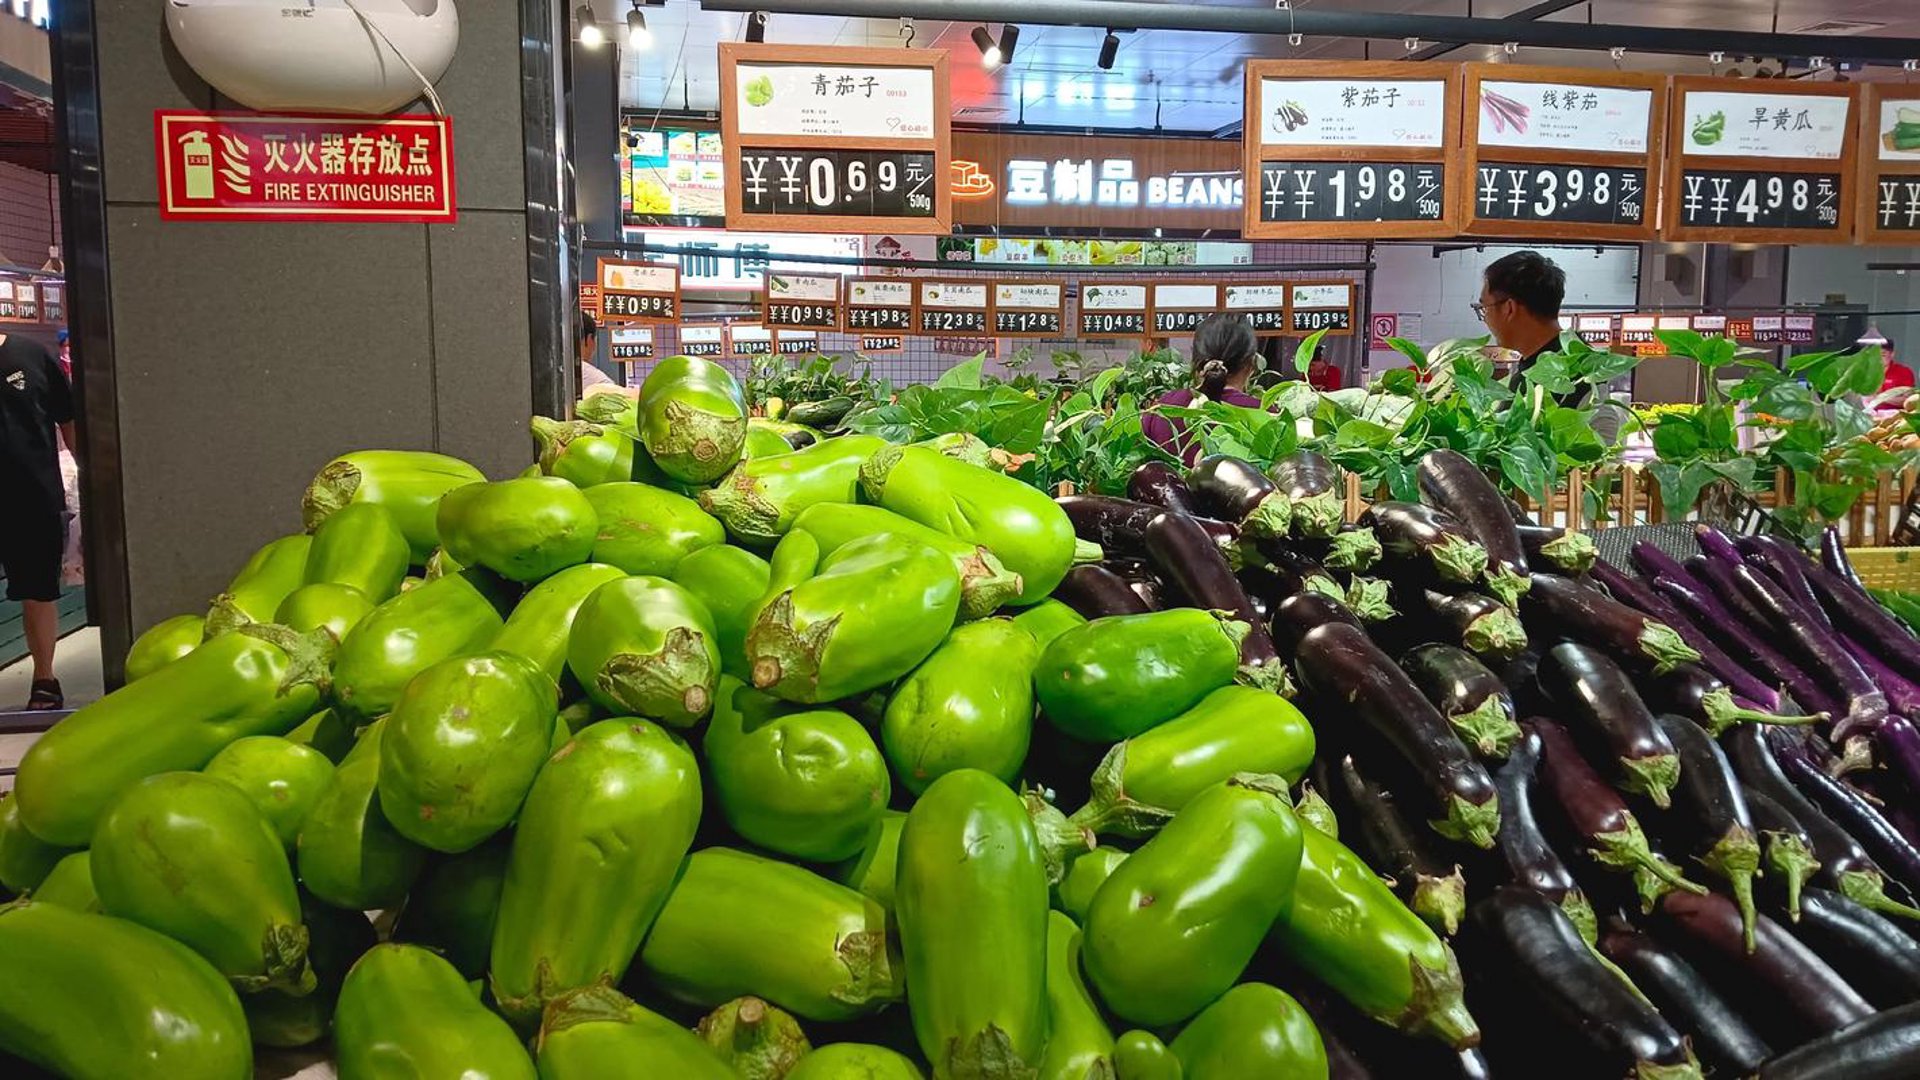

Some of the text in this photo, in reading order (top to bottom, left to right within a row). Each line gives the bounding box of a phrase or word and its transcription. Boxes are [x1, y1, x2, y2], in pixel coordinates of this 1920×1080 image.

[810, 73, 880, 98] 青茄子
[1341, 86, 1401, 108] 紫茄子
[1542, 90, 1598, 111] 线紫茄
[1748, 107, 1813, 131] 旱黄瓜
[263, 133, 433, 176] 灭火器存放点
[1006, 158, 1139, 203] 豆制品
[264, 183, 436, 203] FIRE EXTINGUISHER
[645, 241, 770, 278] 师傅
